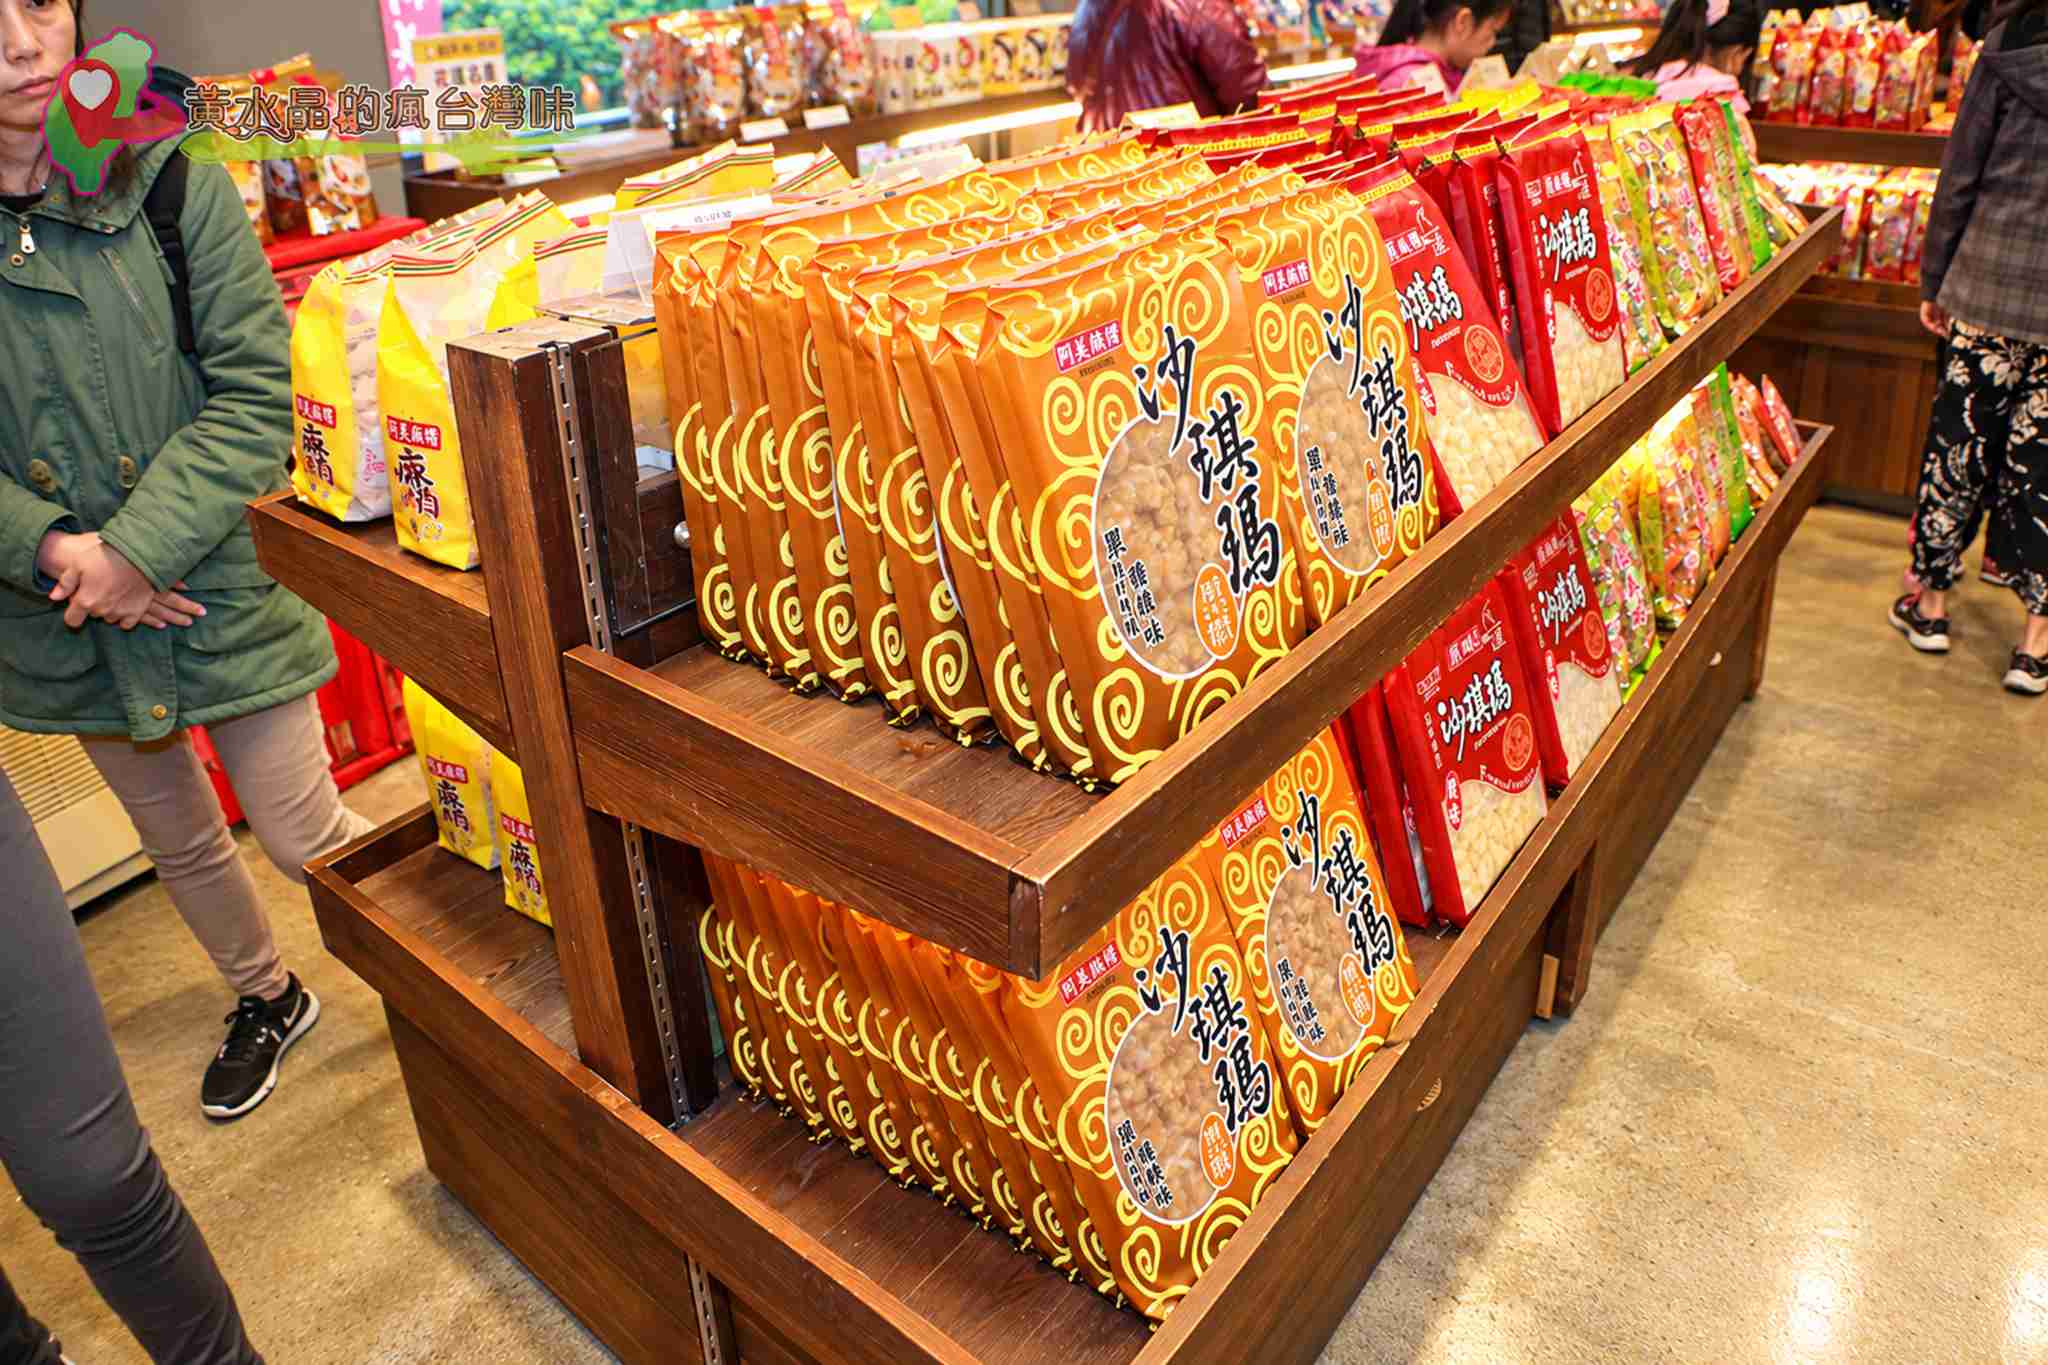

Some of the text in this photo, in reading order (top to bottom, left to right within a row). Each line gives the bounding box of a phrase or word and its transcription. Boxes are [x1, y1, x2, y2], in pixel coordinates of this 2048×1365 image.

[1134, 325, 1282, 594] 沙琪瑪
[1323, 274, 1422, 511] 沙琪瑪
[1281, 791, 1395, 976] 沙琪瑪
[1135, 928, 1272, 1131] 沙琪瑪
